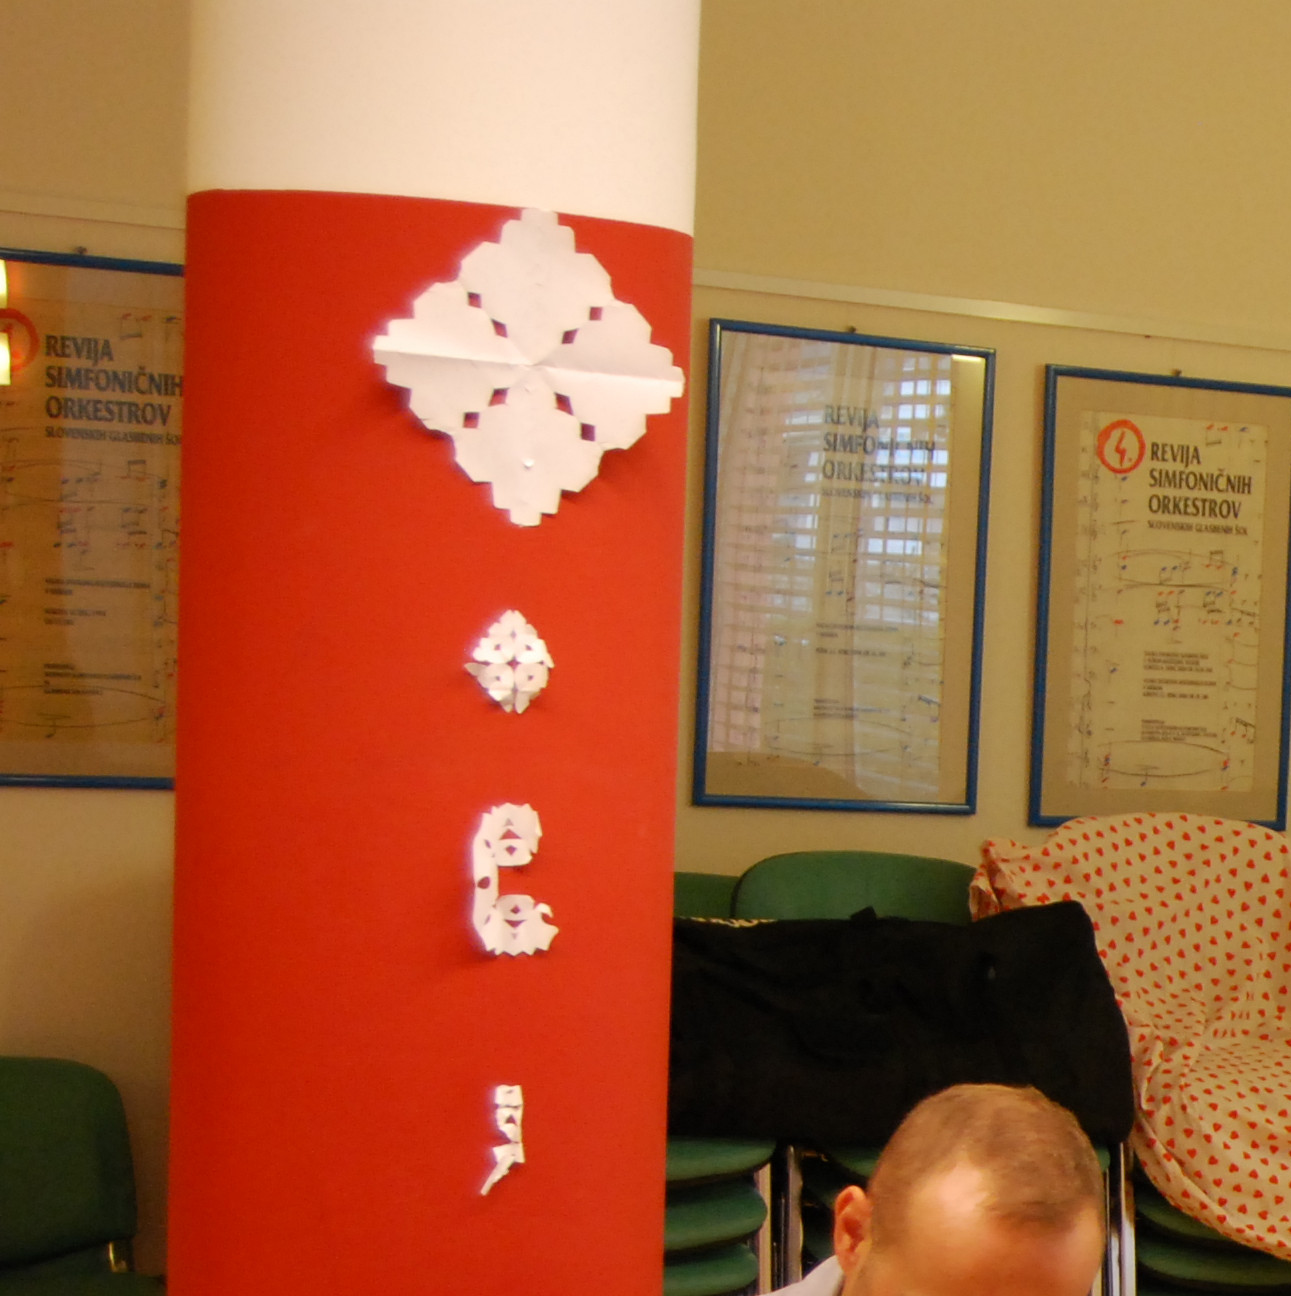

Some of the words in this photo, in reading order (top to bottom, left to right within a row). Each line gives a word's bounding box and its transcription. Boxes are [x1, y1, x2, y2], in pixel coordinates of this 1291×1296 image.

[45, 334, 114, 366] REVIJA
[45, 365, 183, 397] SIMFONIČNIH
[45, 395, 172, 426] ORKESTROV
[825, 404, 880, 432] REVIJA
[1150, 442, 1202, 468] REVIJA
[1149, 467, 1252, 495] SIMFONIČNIH
[1148, 494, 1242, 519] ORKESTROV
